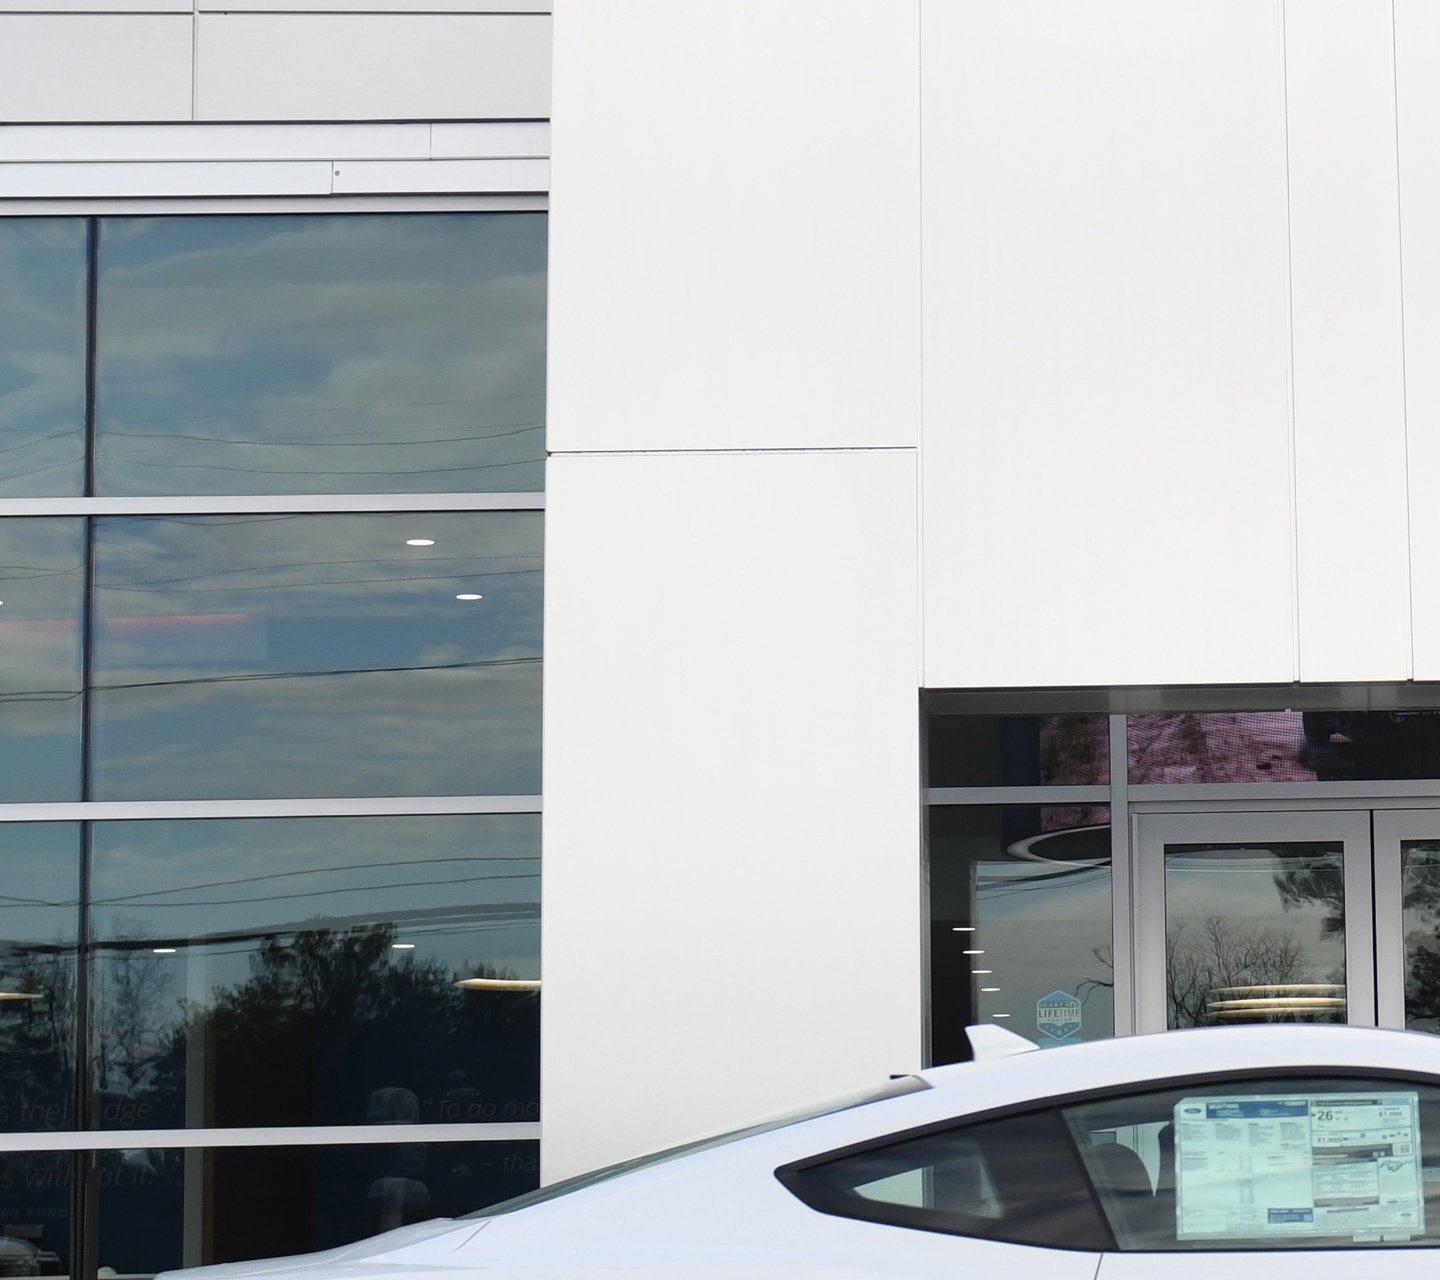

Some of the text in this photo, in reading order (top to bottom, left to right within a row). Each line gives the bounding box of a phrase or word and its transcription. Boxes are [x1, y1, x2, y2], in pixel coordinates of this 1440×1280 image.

[1038, 1009, 1080, 1018] LIFETIME
[468, 1098, 497, 1118] do
[1317, 1110, 1334, 1121] 26
